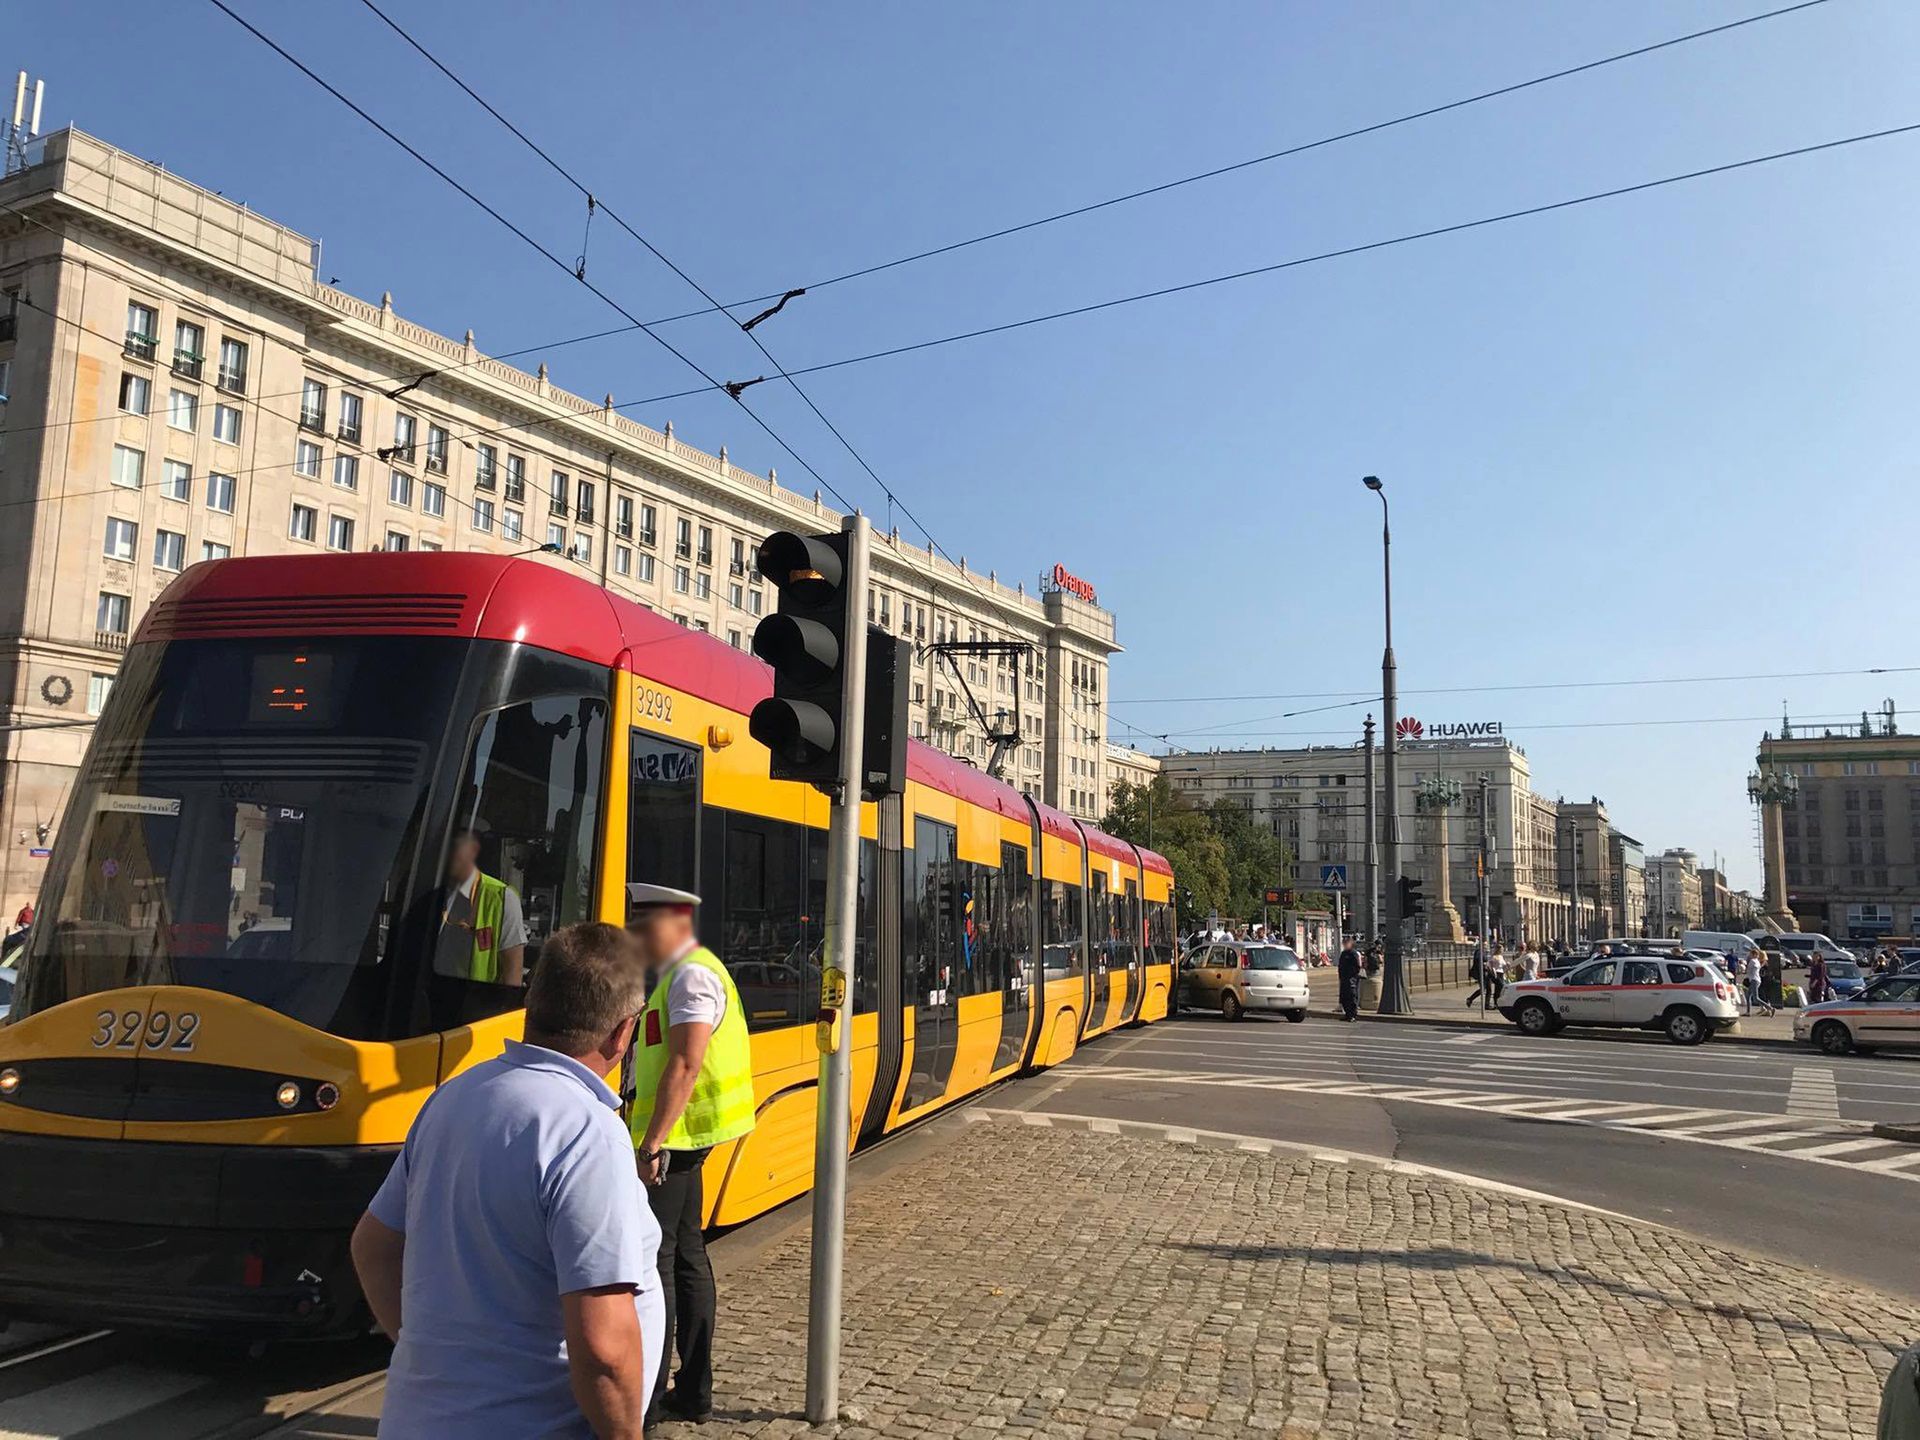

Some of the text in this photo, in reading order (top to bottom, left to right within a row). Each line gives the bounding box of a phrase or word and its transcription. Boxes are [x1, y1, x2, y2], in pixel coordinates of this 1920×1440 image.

[1054, 563, 1095, 602] Orange
[636, 685, 673, 722] 3292
[1429, 721, 1503, 737] HUAWEI
[91, 1010, 200, 1051] 3292
